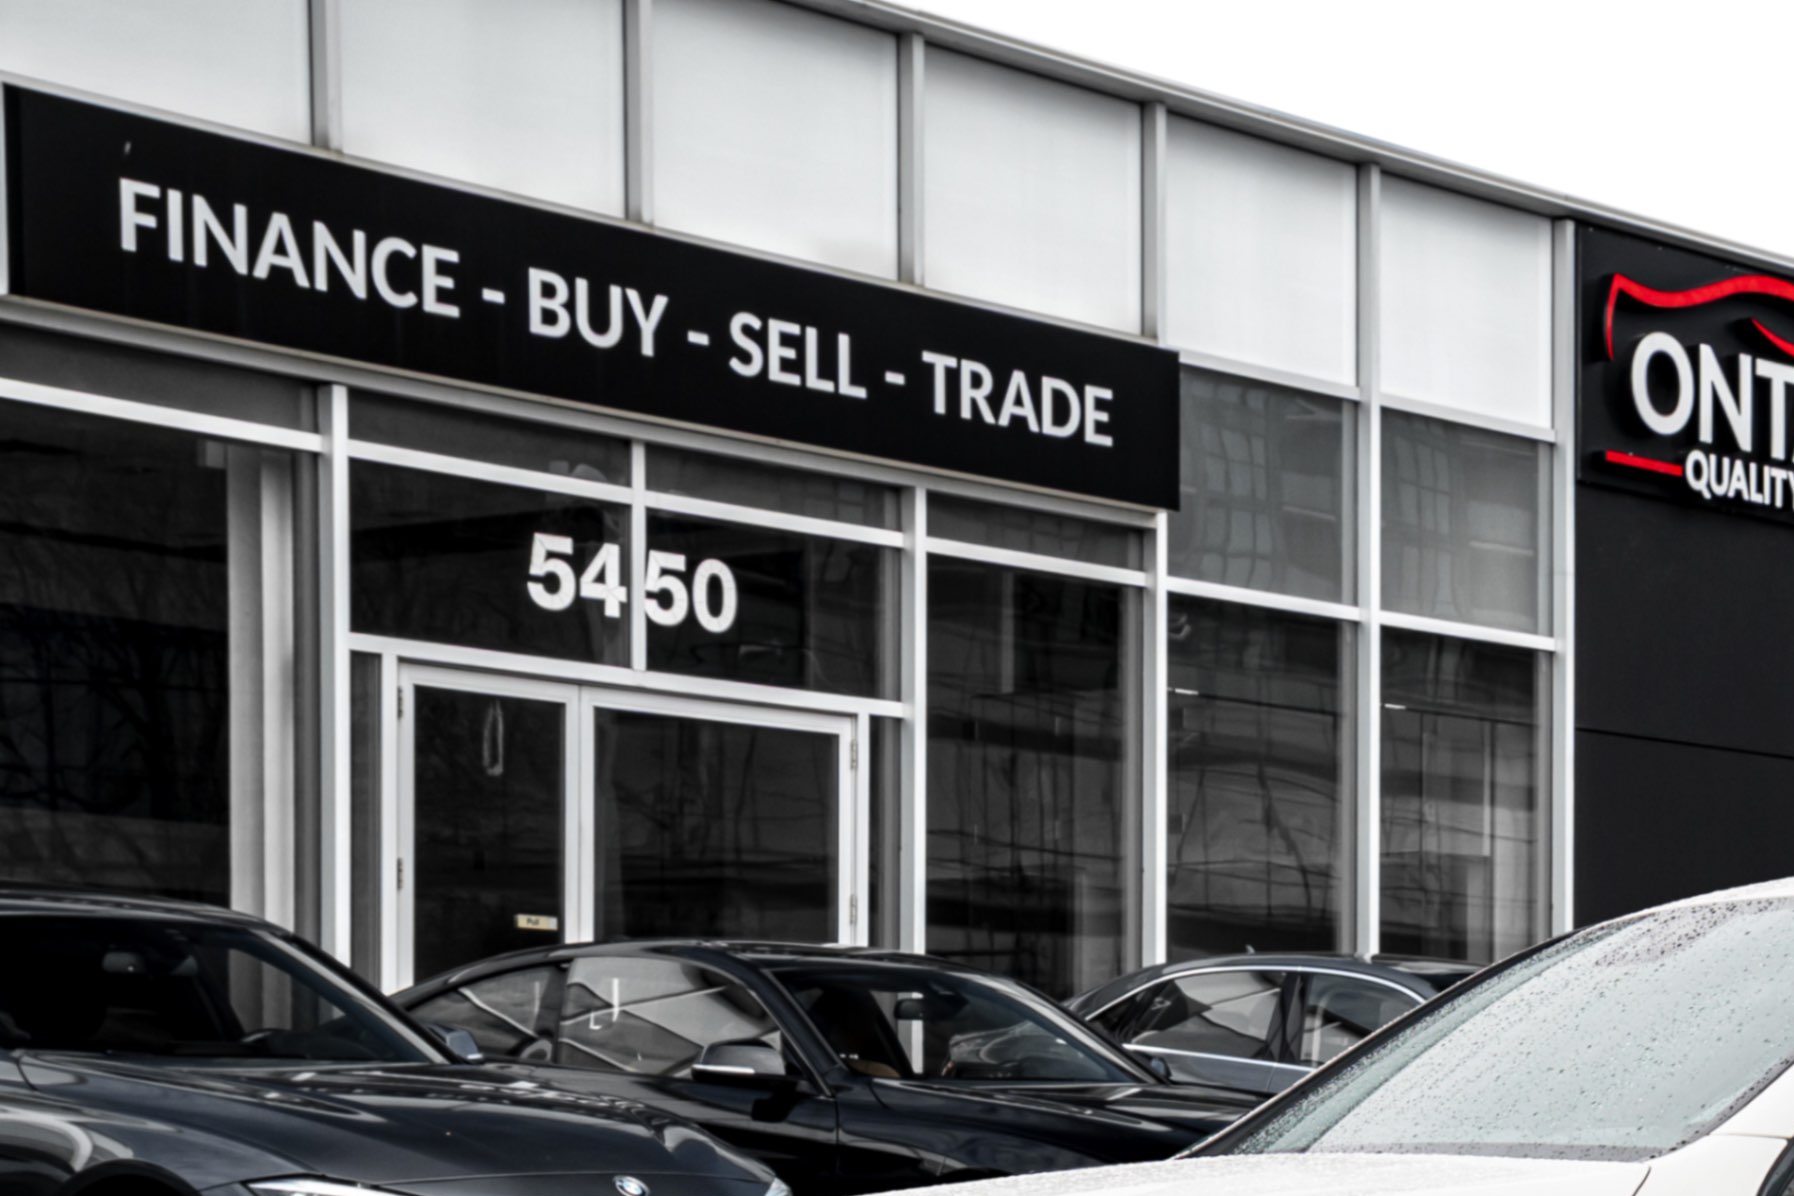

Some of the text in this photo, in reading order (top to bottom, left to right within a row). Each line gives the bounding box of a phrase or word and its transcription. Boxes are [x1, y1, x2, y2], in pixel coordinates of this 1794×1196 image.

[119, 177, 461, 319] FINANCE
[528, 266, 669, 358] BUY
[729, 310, 868, 400] SELL
[922, 349, 1114, 448] TRADE
[526, 532, 739, 635] 5450
